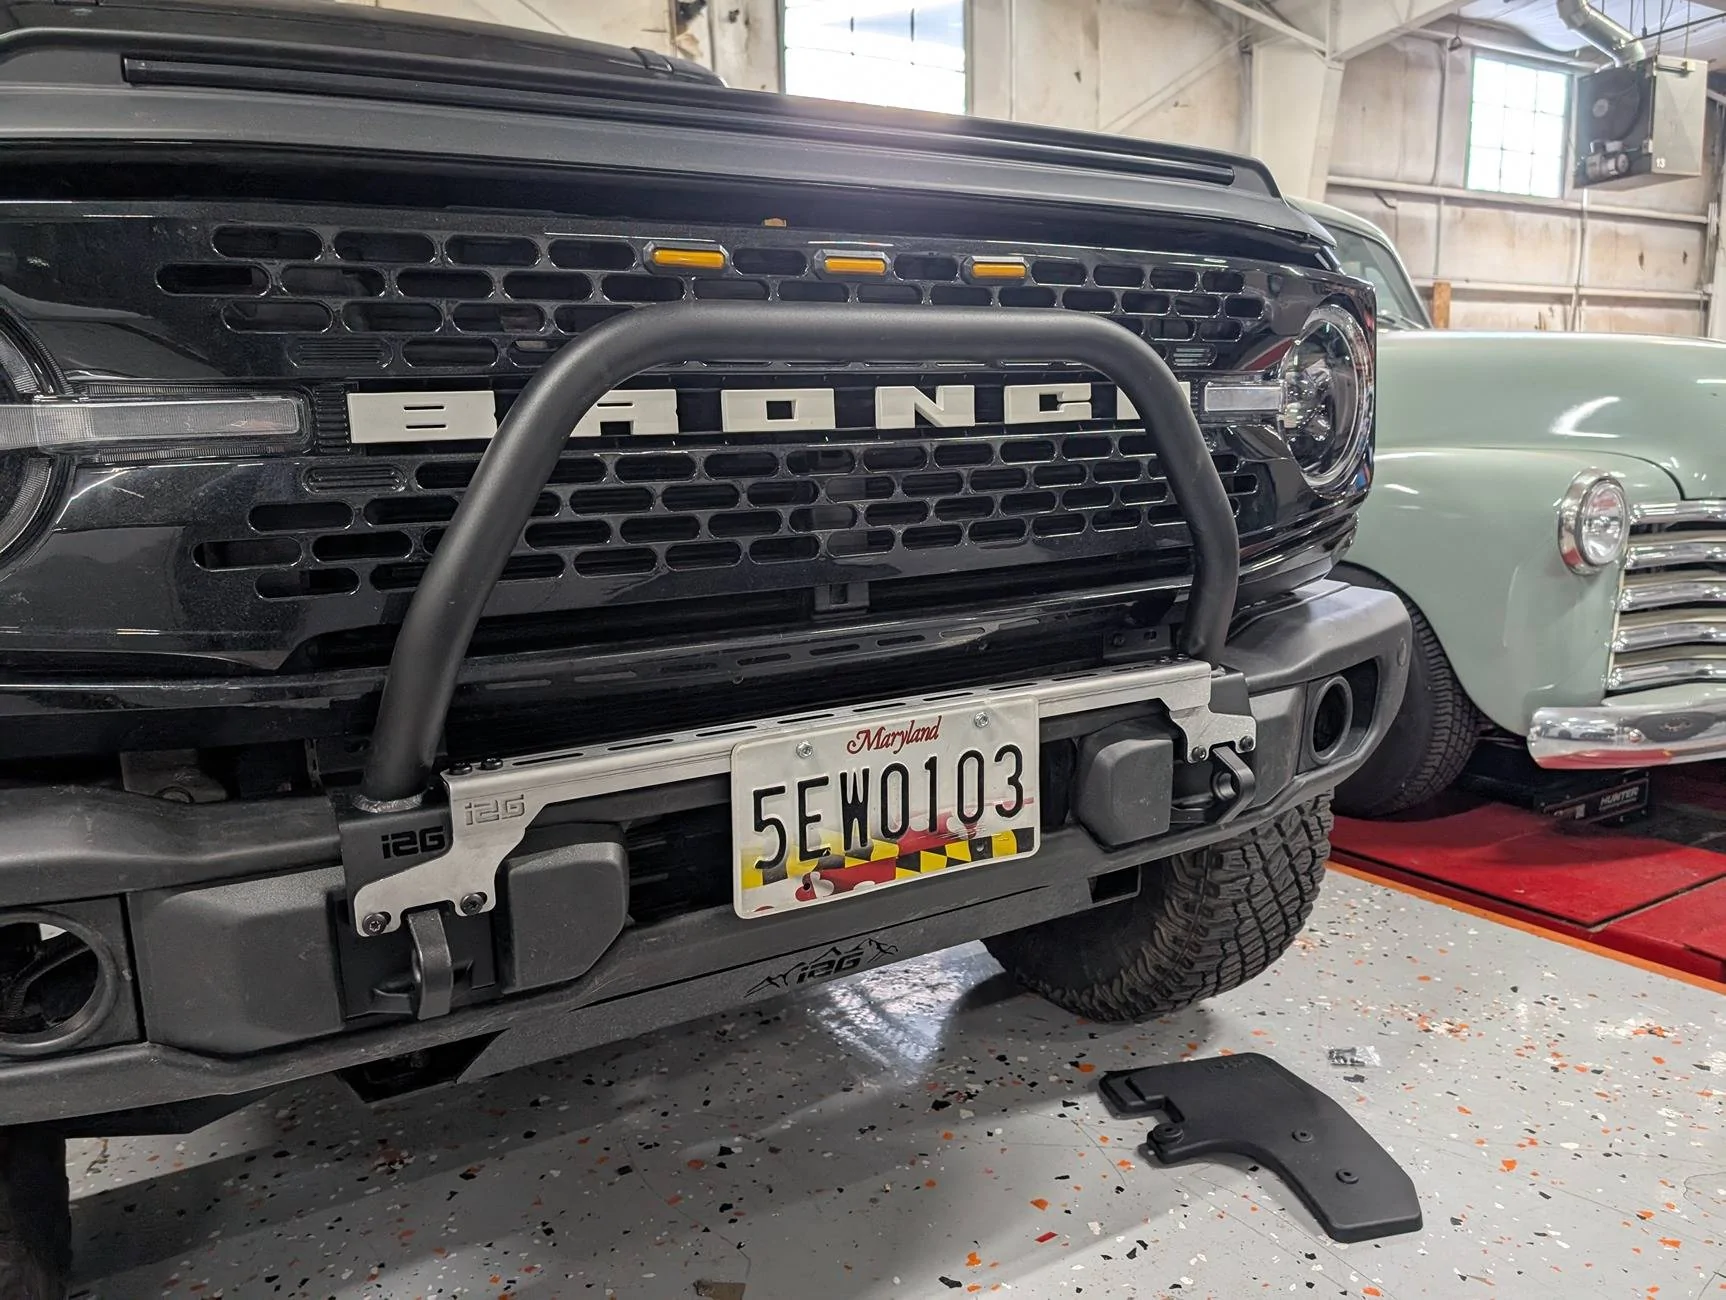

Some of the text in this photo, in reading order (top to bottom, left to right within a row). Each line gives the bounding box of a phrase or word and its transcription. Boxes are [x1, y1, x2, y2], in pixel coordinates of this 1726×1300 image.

[846, 715, 943, 755] Maryland
[752, 743, 1025, 870] 5EW0103
[1600, 786, 1640, 806] HUNTER
